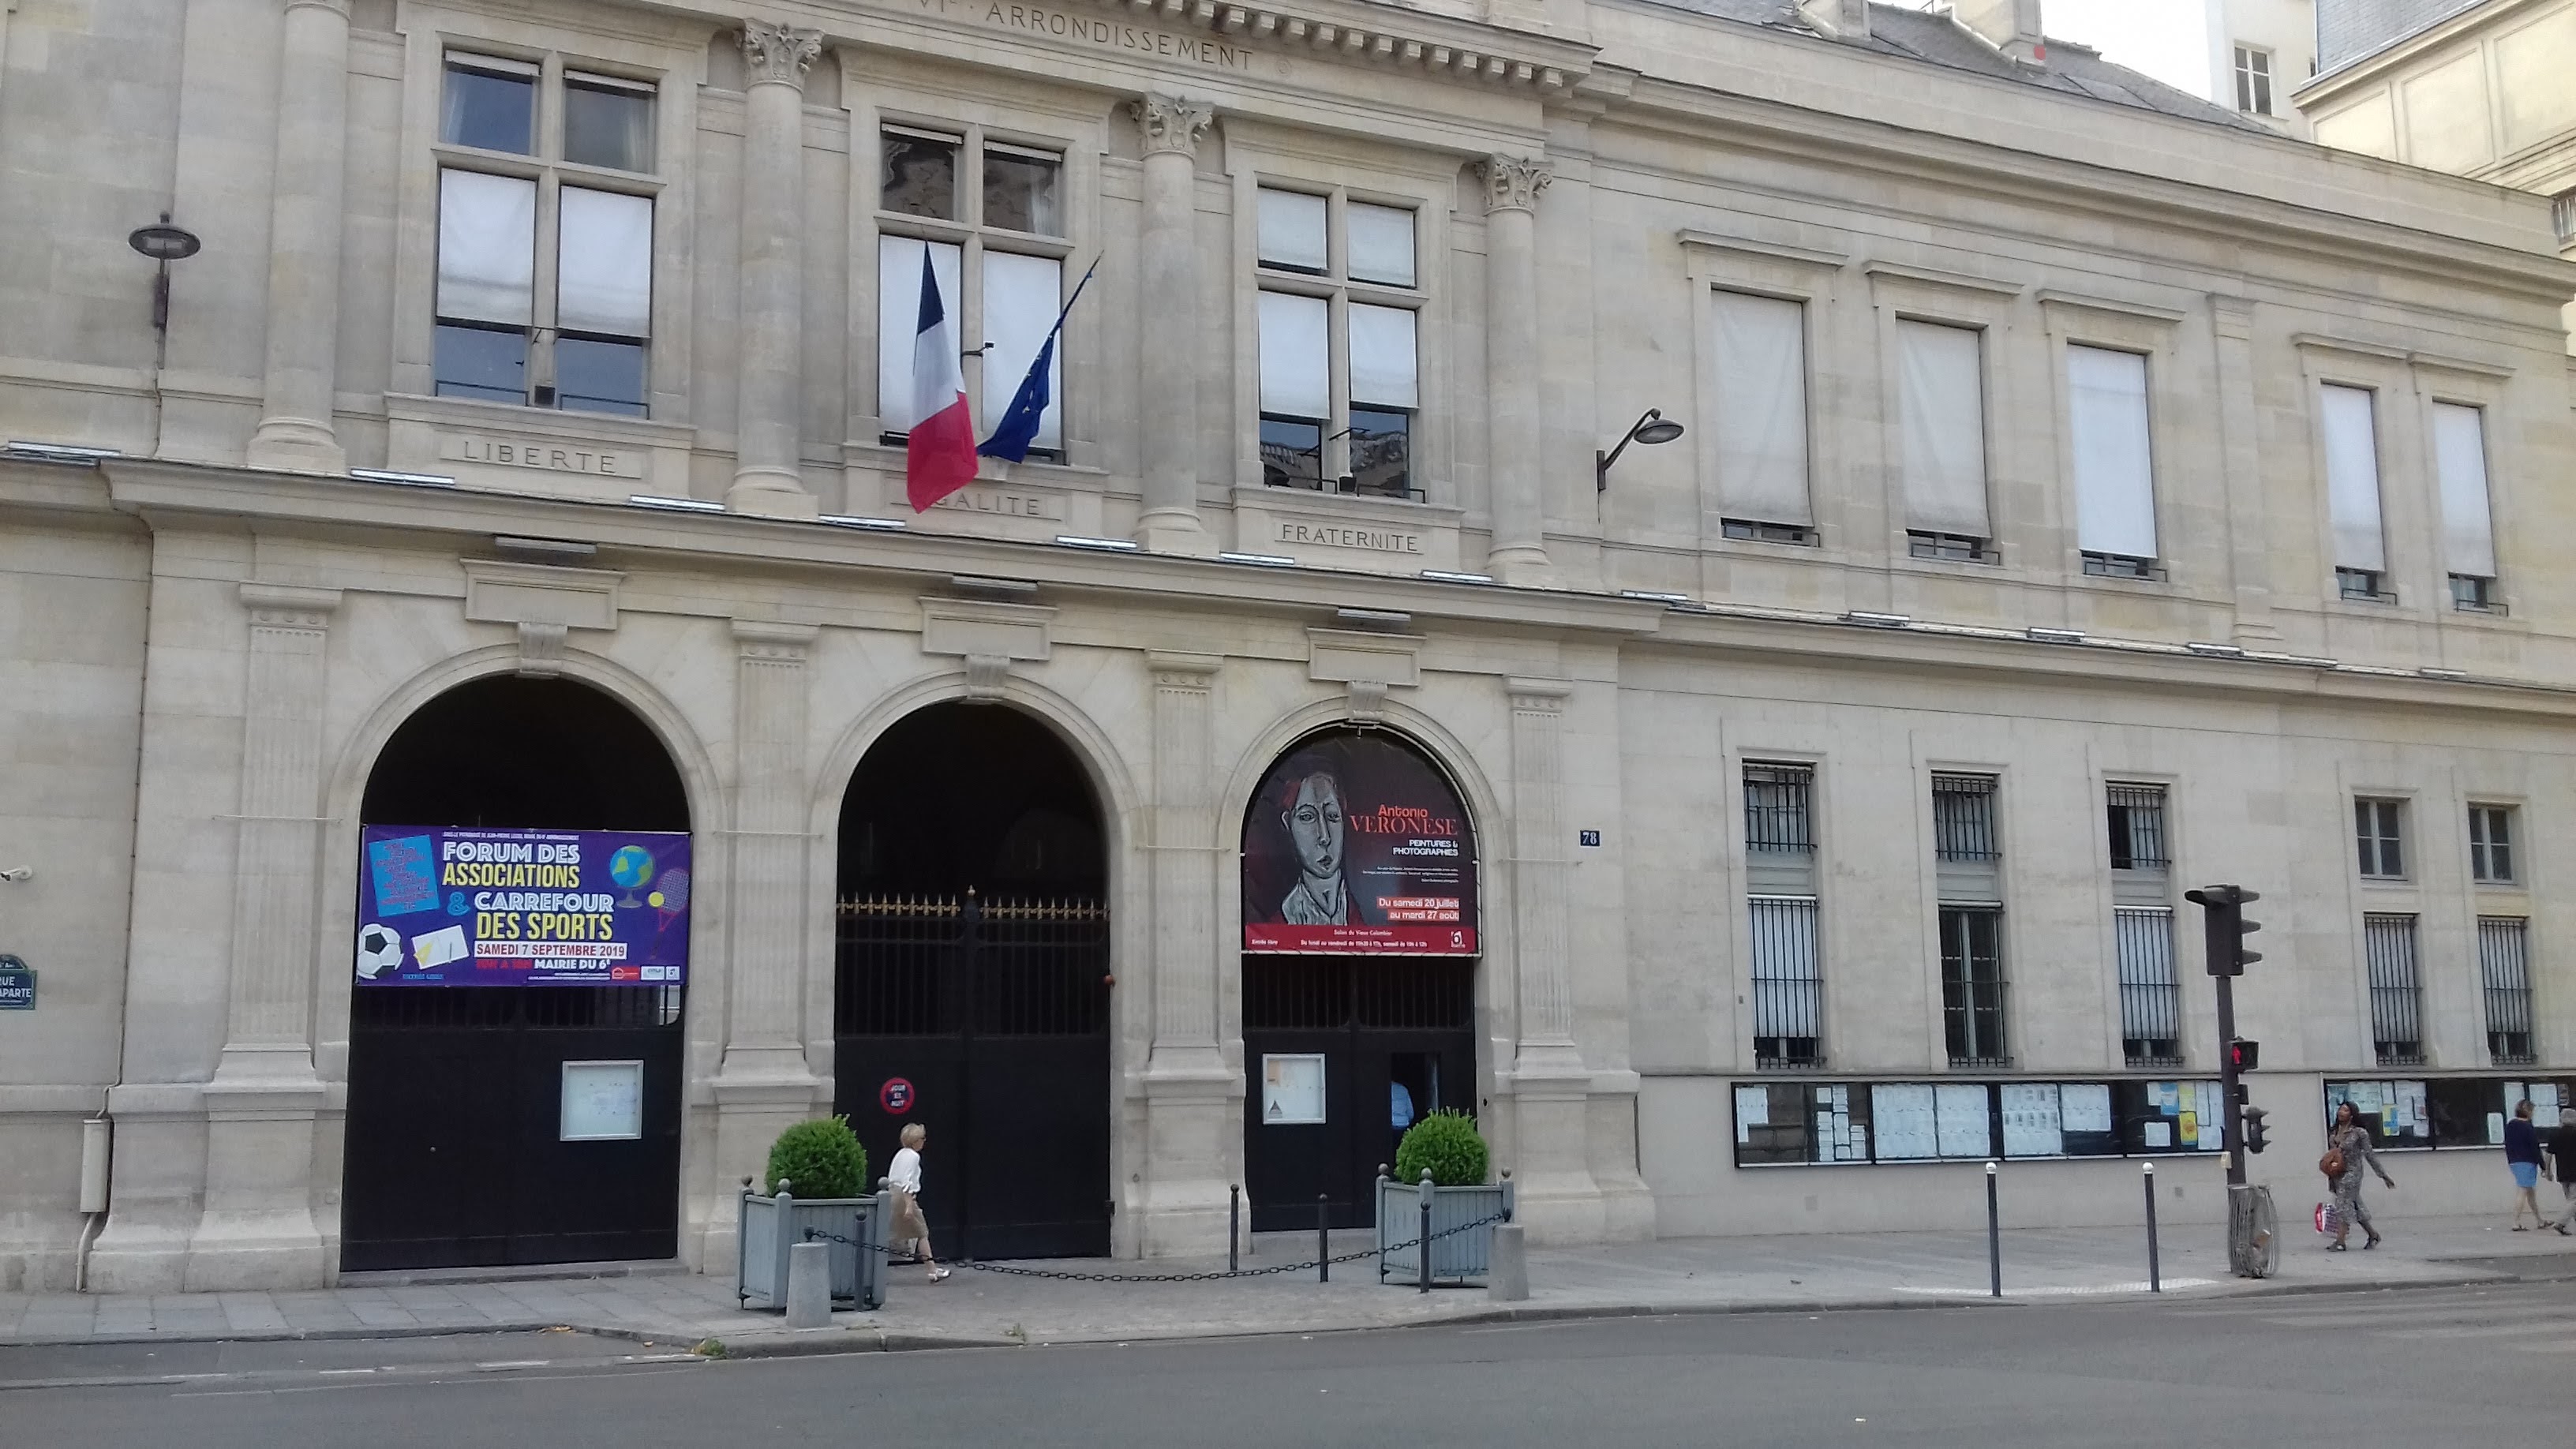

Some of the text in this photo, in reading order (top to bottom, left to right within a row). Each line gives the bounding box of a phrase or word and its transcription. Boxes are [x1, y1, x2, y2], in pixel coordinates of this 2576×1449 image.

[986, 2, 1253, 70] ARRONDISSEMENT
[464, 441, 616, 474] LIBERTE
[934, 492, 1039, 515] ALITE
[1282, 524, 1417, 551] FRATERNITE
[1378, 803, 1428, 818] Antonio
[1350, 815, 1458, 835] VERONESE
[1582, 831, 1597, 844] 78
[443, 841, 580, 864] FORUM DES
[1393, 847, 1458, 856] PHOTOGRAPHIES
[442, 863, 580, 888] ASSOCIATIONS
[447, 891, 614, 916] & CARREFOUR
[1379, 898, 1458, 909] Du samedi 20 juillet
[1402, 909, 1425, 919] mardi
[1439, 910, 1458, 919] août
[477, 912, 613, 940] DES SPORTS
[477, 943, 625, 957] SAMEDI 7 SEPTEMBRE 2019
[534, 959, 577, 969] MAIRIE
[578, 960, 597, 969] DU
[0, 975, 15, 986] UE
[0, 987, 32, 998] PARTE
